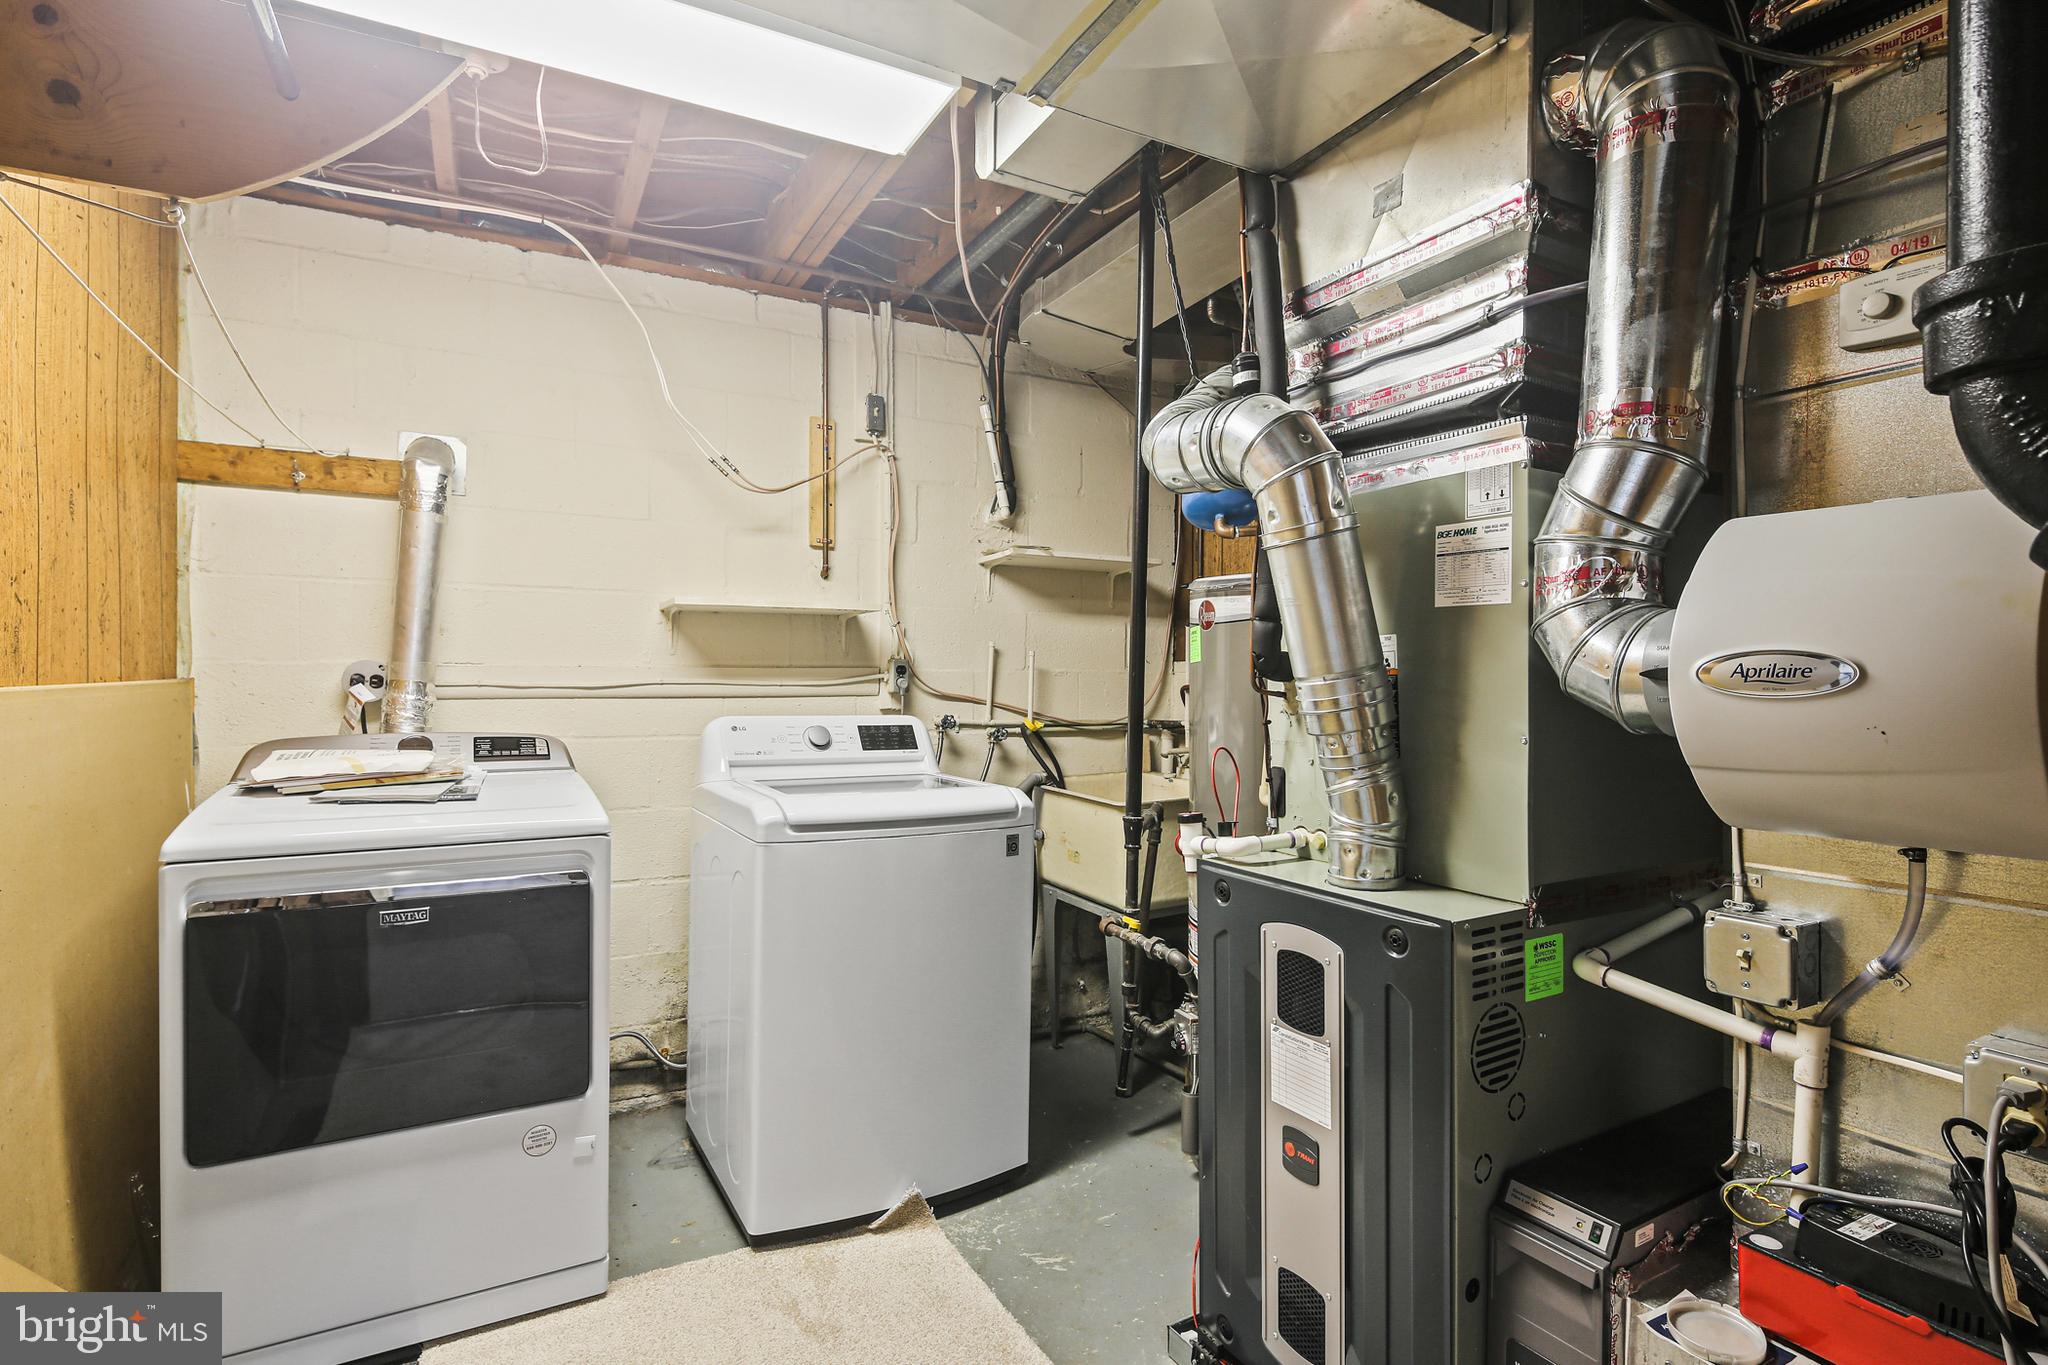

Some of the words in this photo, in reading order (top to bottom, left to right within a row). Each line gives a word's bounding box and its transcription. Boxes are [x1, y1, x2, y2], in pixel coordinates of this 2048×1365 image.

[1874, 25, 1930, 55] Shurtape
[1890, 235, 1930, 257] 04/19
[1803, 272, 1849, 291] 181B-FX
[1453, 527, 1478, 538] HOME
[1593, 567, 1606, 577] AF
[1730, 662, 1813, 684] Aprilaire
[383, 911, 427, 923] MAYTAG
[1539, 940, 1557, 950] WSSC
